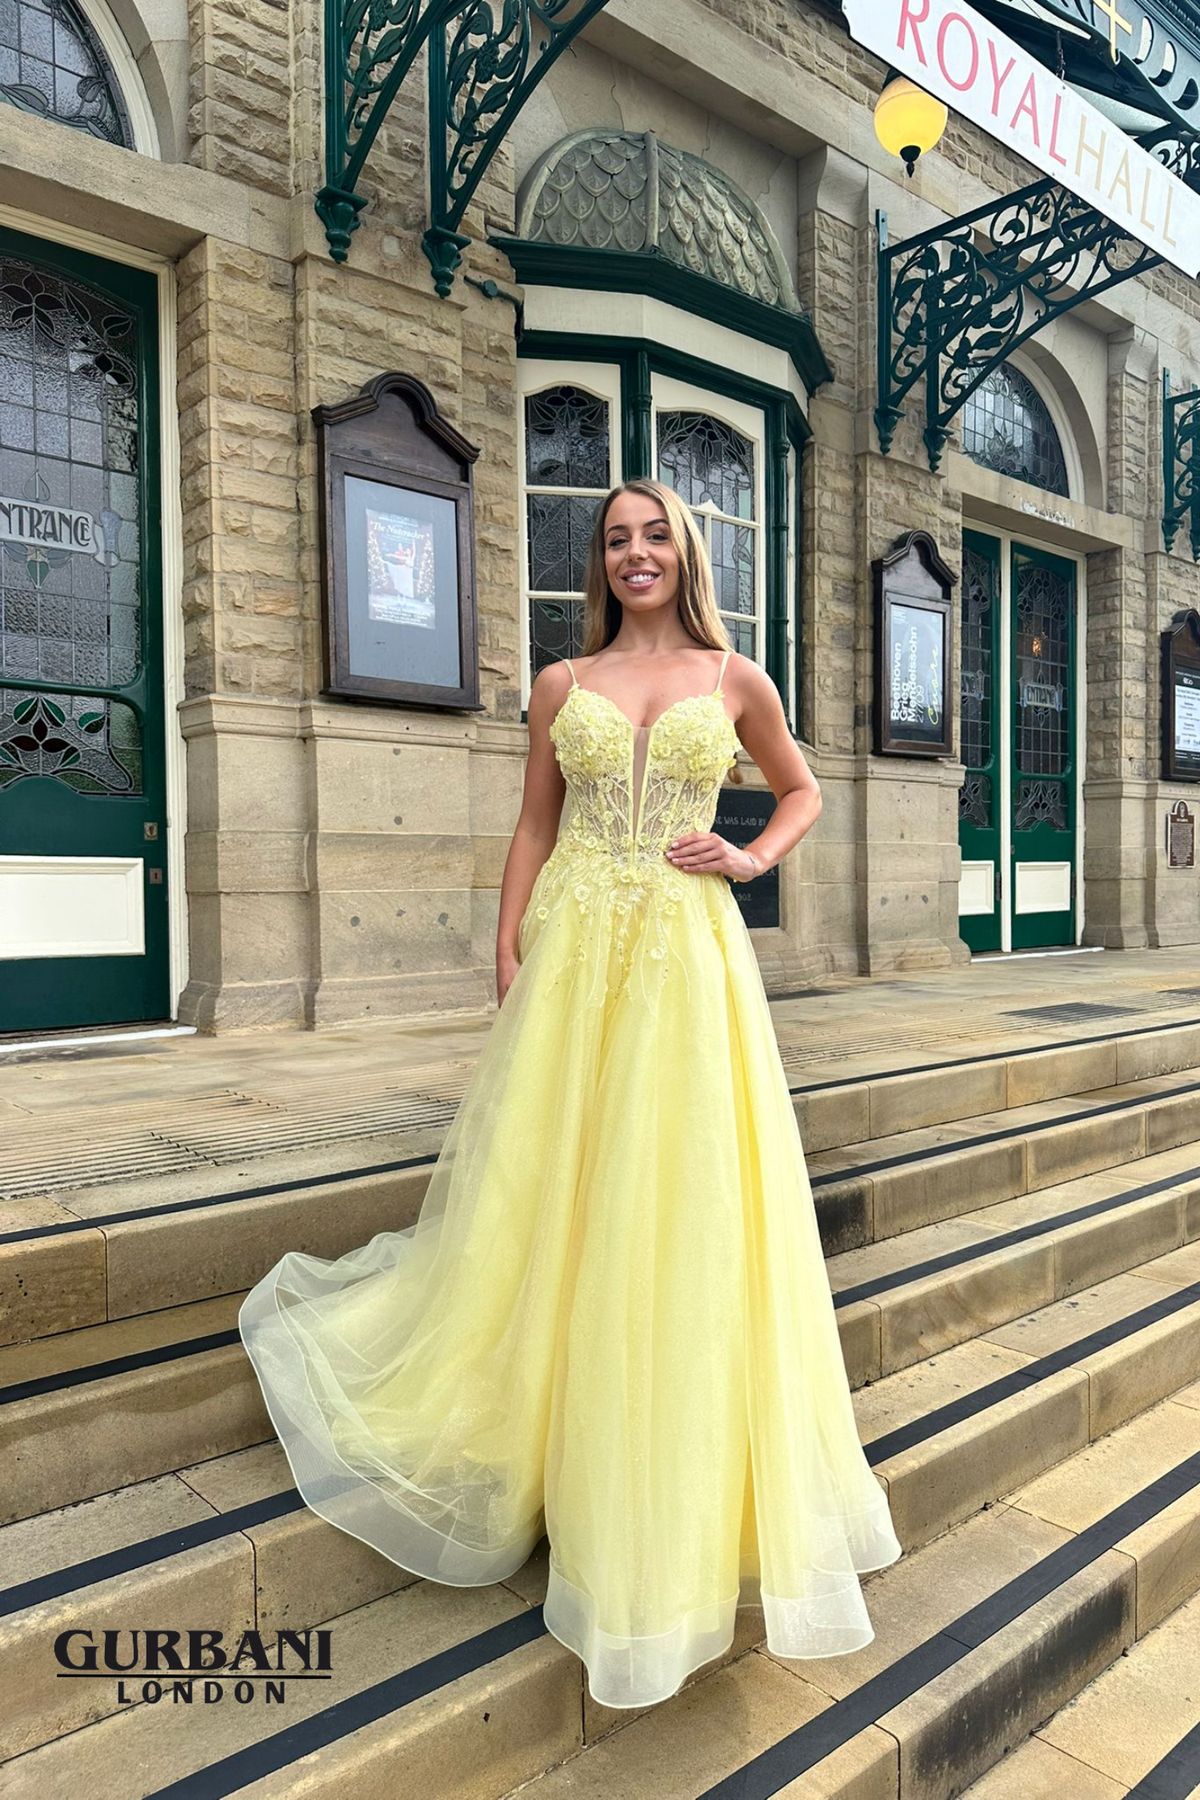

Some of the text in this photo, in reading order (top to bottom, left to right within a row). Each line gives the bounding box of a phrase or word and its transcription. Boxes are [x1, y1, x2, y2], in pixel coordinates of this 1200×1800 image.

[897, 0, 1067, 166] ROYAL
[373, 521, 386, 532] The
[387, 525, 425, 540] Nutcracker
[890, 643, 902, 721] Beethoven
[899, 682, 910, 721] Grieg
[907, 626, 918, 722] Mendelssohn
[928, 644, 939, 725] Cuore
[723, 816, 738, 825] WAS
[740, 817, 757, 826] LAID
[758, 817, 767, 827] BY
